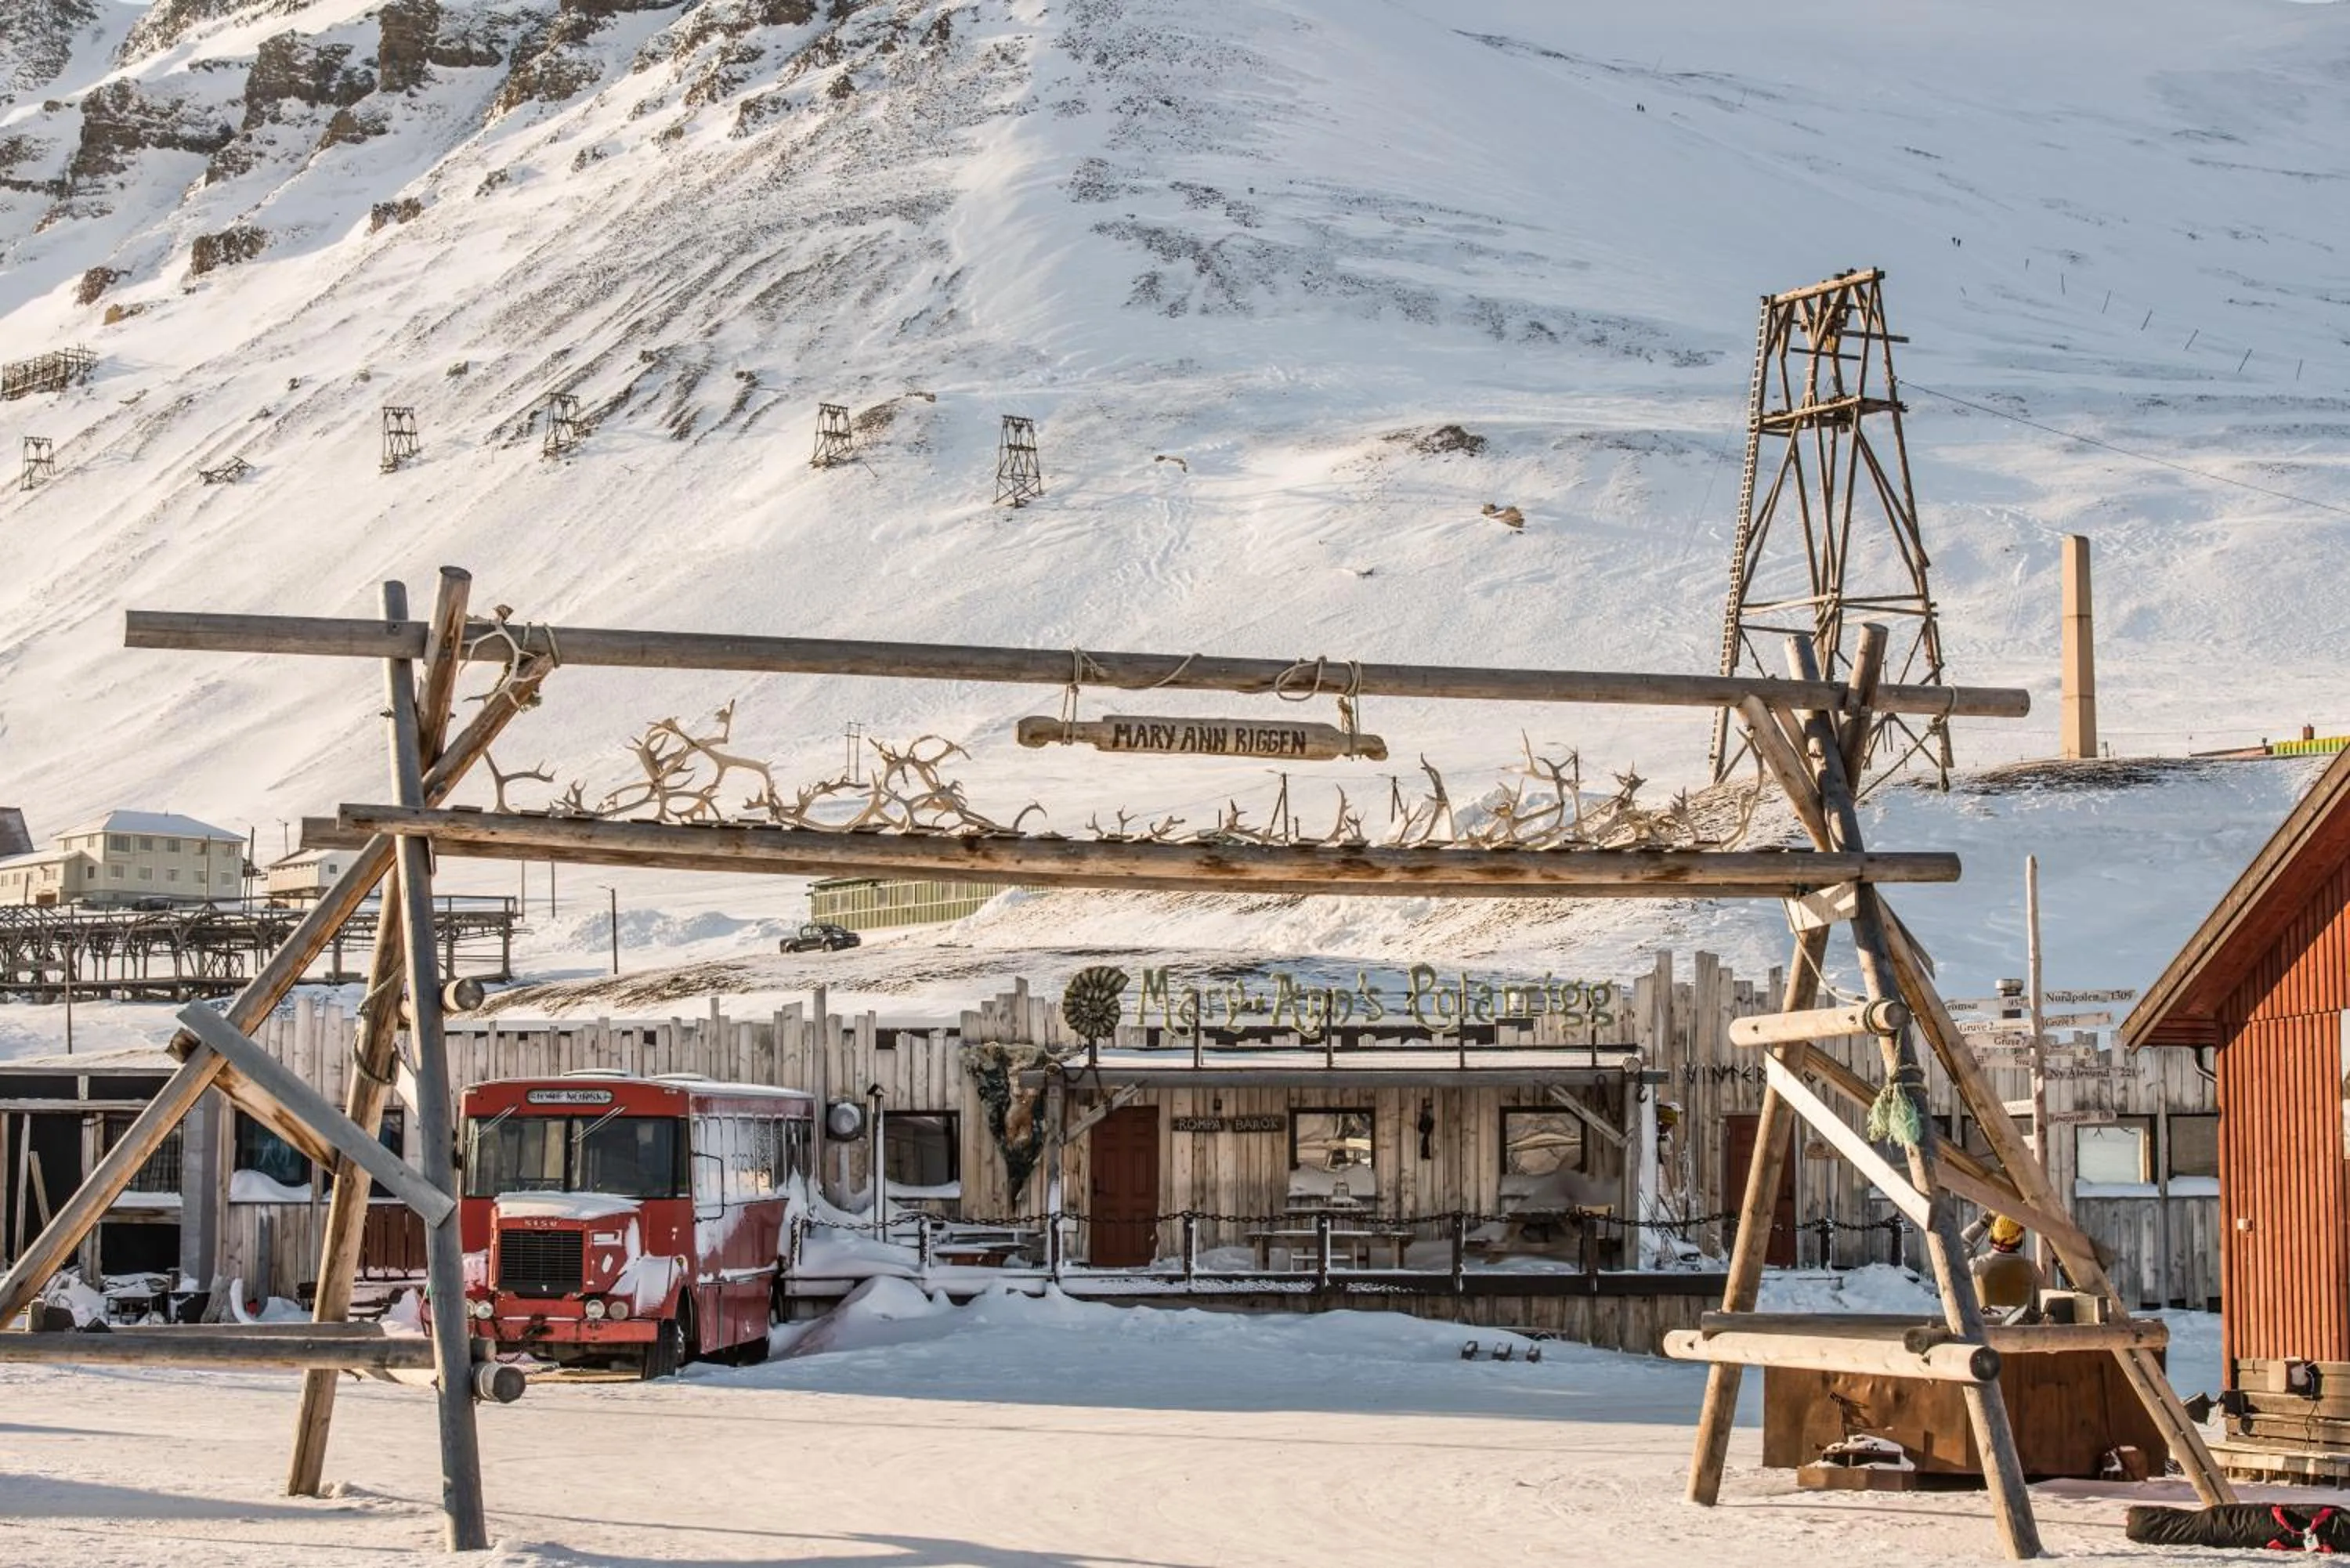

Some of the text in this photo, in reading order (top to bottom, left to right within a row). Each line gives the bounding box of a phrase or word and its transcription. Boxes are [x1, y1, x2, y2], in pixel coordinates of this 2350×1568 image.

[1112, 723, 1307, 754] MARY ANN RIGGEN
